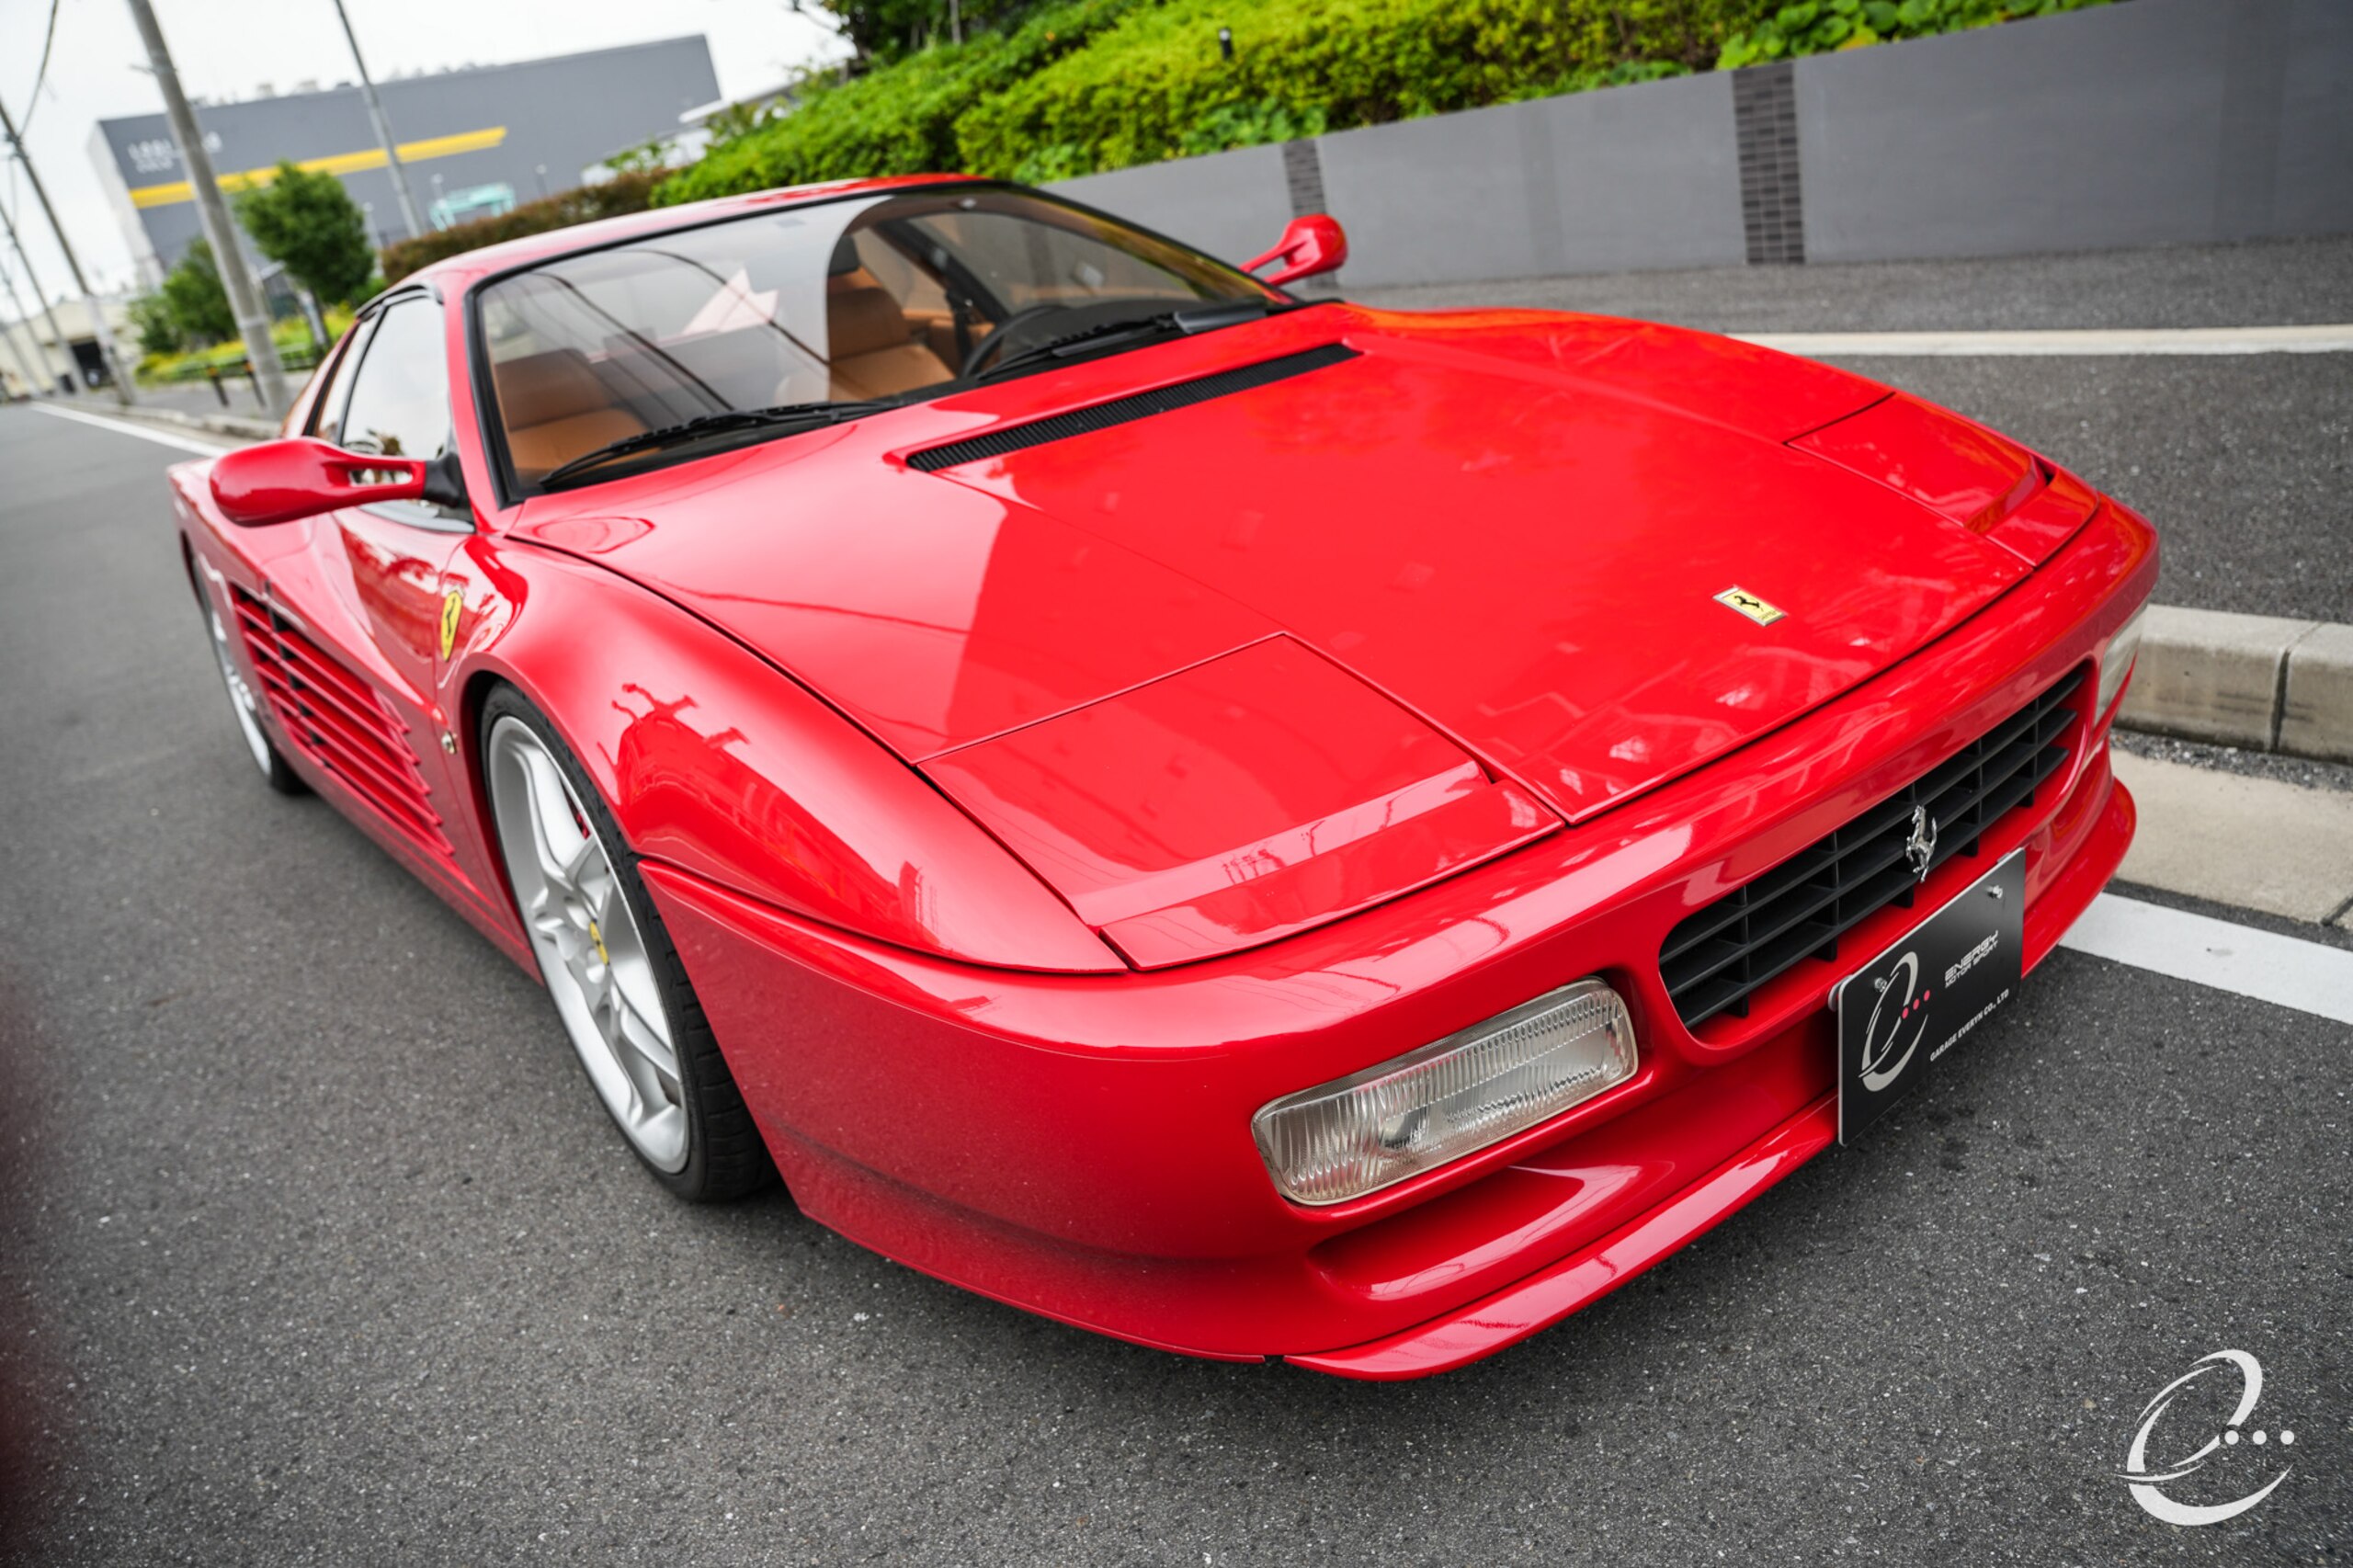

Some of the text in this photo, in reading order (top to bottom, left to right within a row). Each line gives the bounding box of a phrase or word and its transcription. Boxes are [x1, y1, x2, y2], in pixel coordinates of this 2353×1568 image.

[1945, 929, 1998, 981] ENERGY
[1945, 939, 1998, 988] MOTOR SPORT
[1930, 1033, 1957, 1062] GARAGE
